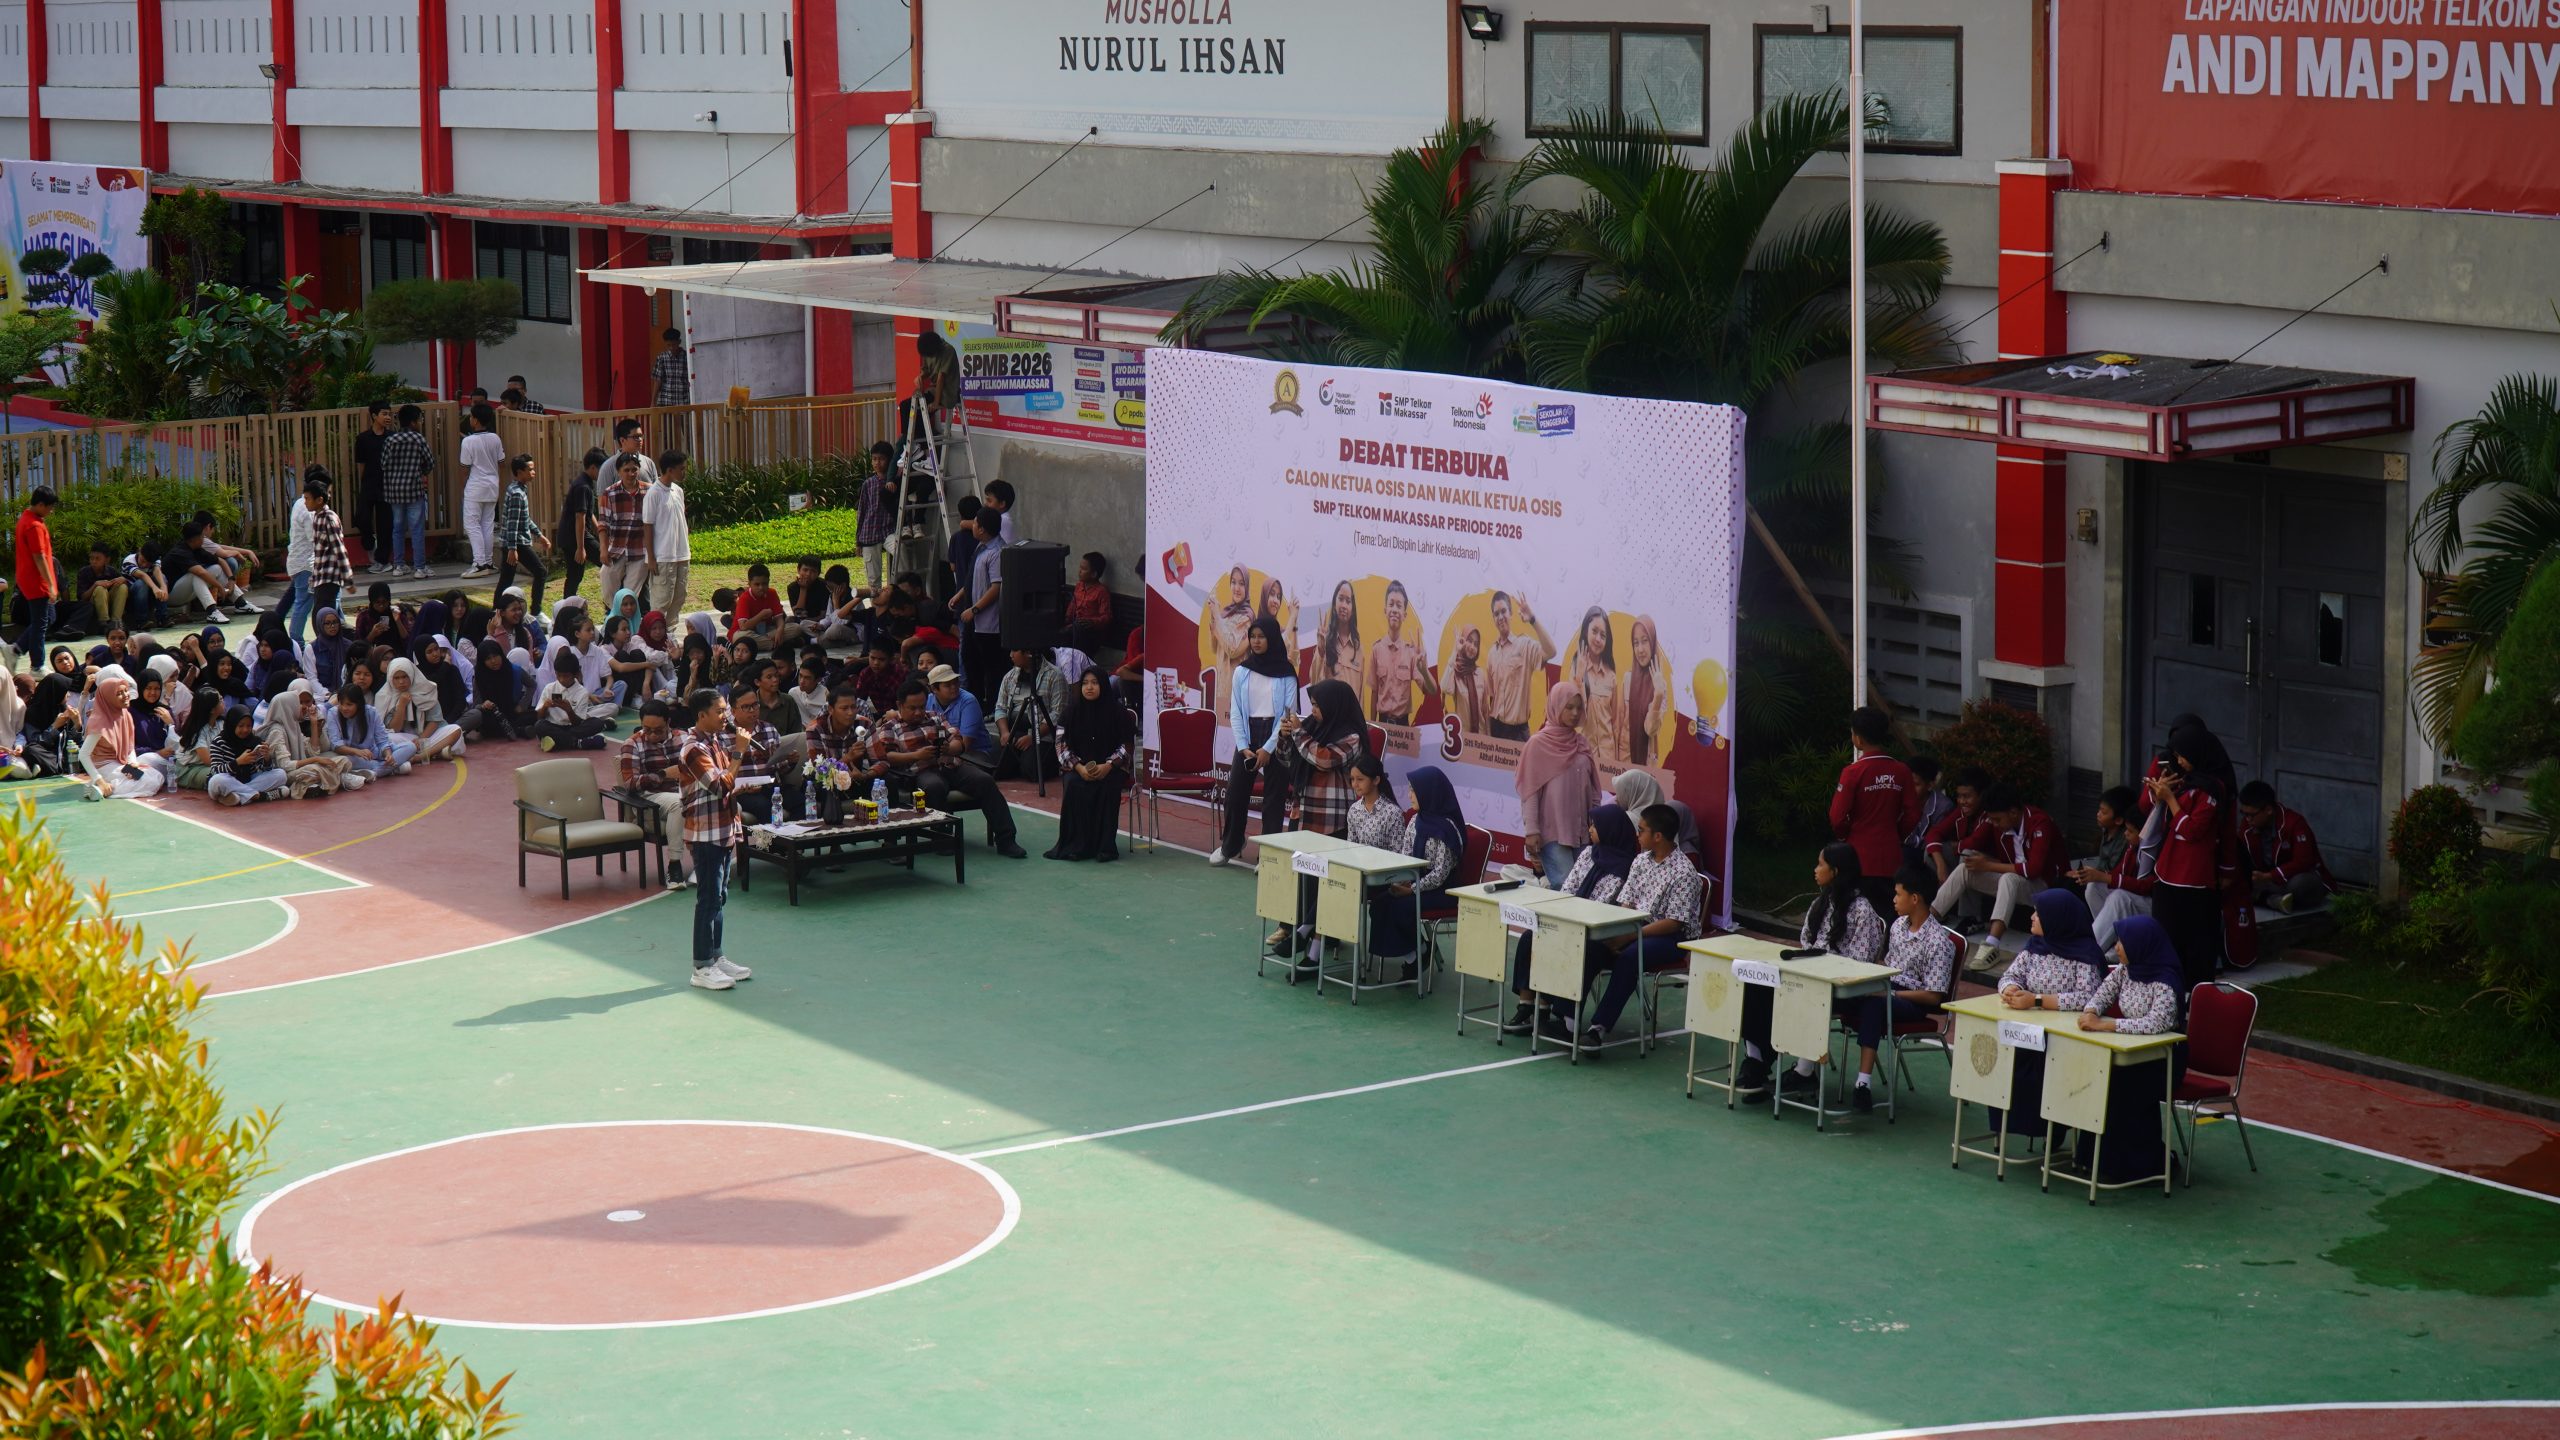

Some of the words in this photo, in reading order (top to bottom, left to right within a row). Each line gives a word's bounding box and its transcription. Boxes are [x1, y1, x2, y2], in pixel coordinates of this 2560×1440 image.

[1105, 0, 1232, 24] MUSHOLLA
[2185, 0, 2319, 23] LAPANGAN
[2325, 0, 2423, 25] INDOOR
[2432, 0, 2538, 28] TELKOM
[1059, 36, 1166, 72] NURUL
[1179, 37, 1286, 75] IHSAN
[2162, 34, 2282, 96] ANDI
[2297, 36, 2560, 106] MAPPANY
[962, 353, 1009, 377] SPMB
[1010, 352, 1052, 376] 2026
[1114, 365, 1127, 374] AYO
[964, 379, 981, 391] SMP
[981, 379, 1009, 390] TELKOM
[1009, 378, 1050, 390] MAKASSAR
[1394, 396, 1410, 406] SMP
[1128, 409, 1146, 419] ppdb.
[1333, 405, 1356, 416] Telkom
[1393, 407, 1428, 420] Makassar
[1450, 406, 1474, 418] Telkom
[1453, 418, 1486, 431] Indonesia
[1339, 437, 1407, 469] DEBAT
[1410, 445, 1509, 481] TERBUKA
[1285, 468, 1329, 489] CALON
[1331, 473, 1373, 494] KETUA
[1375, 479, 1405, 498] OSIS
[1407, 482, 1436, 502] DAN
[1439, 486, 1482, 508] WAKIL
[1484, 492, 1528, 514] KETUA
[1530, 498, 1562, 518] OSIS
[1313, 499, 1336, 515] SMP
[1338, 502, 1381, 521] TELKOM
[1383, 508, 1445, 530] MAKASSAR
[1447, 516, 1493, 536] PERIODE
[1495, 522, 1523, 540] 2026
[1377, 534, 1392, 548] Dari
[1392, 536, 1417, 553] Disiplin
[1417, 541, 1435, 554] Lahir
[1441, 713, 1464, 762] 3
[1875, 774, 1895, 784] MPK
[1296, 859, 1320, 872] PASLON
[1504, 910, 1528, 924] PASLON
[1737, 967, 1769, 982] PASLON
[1770, 974, 1776, 984] 2
[2004, 1029, 2032, 1044] PASLON
